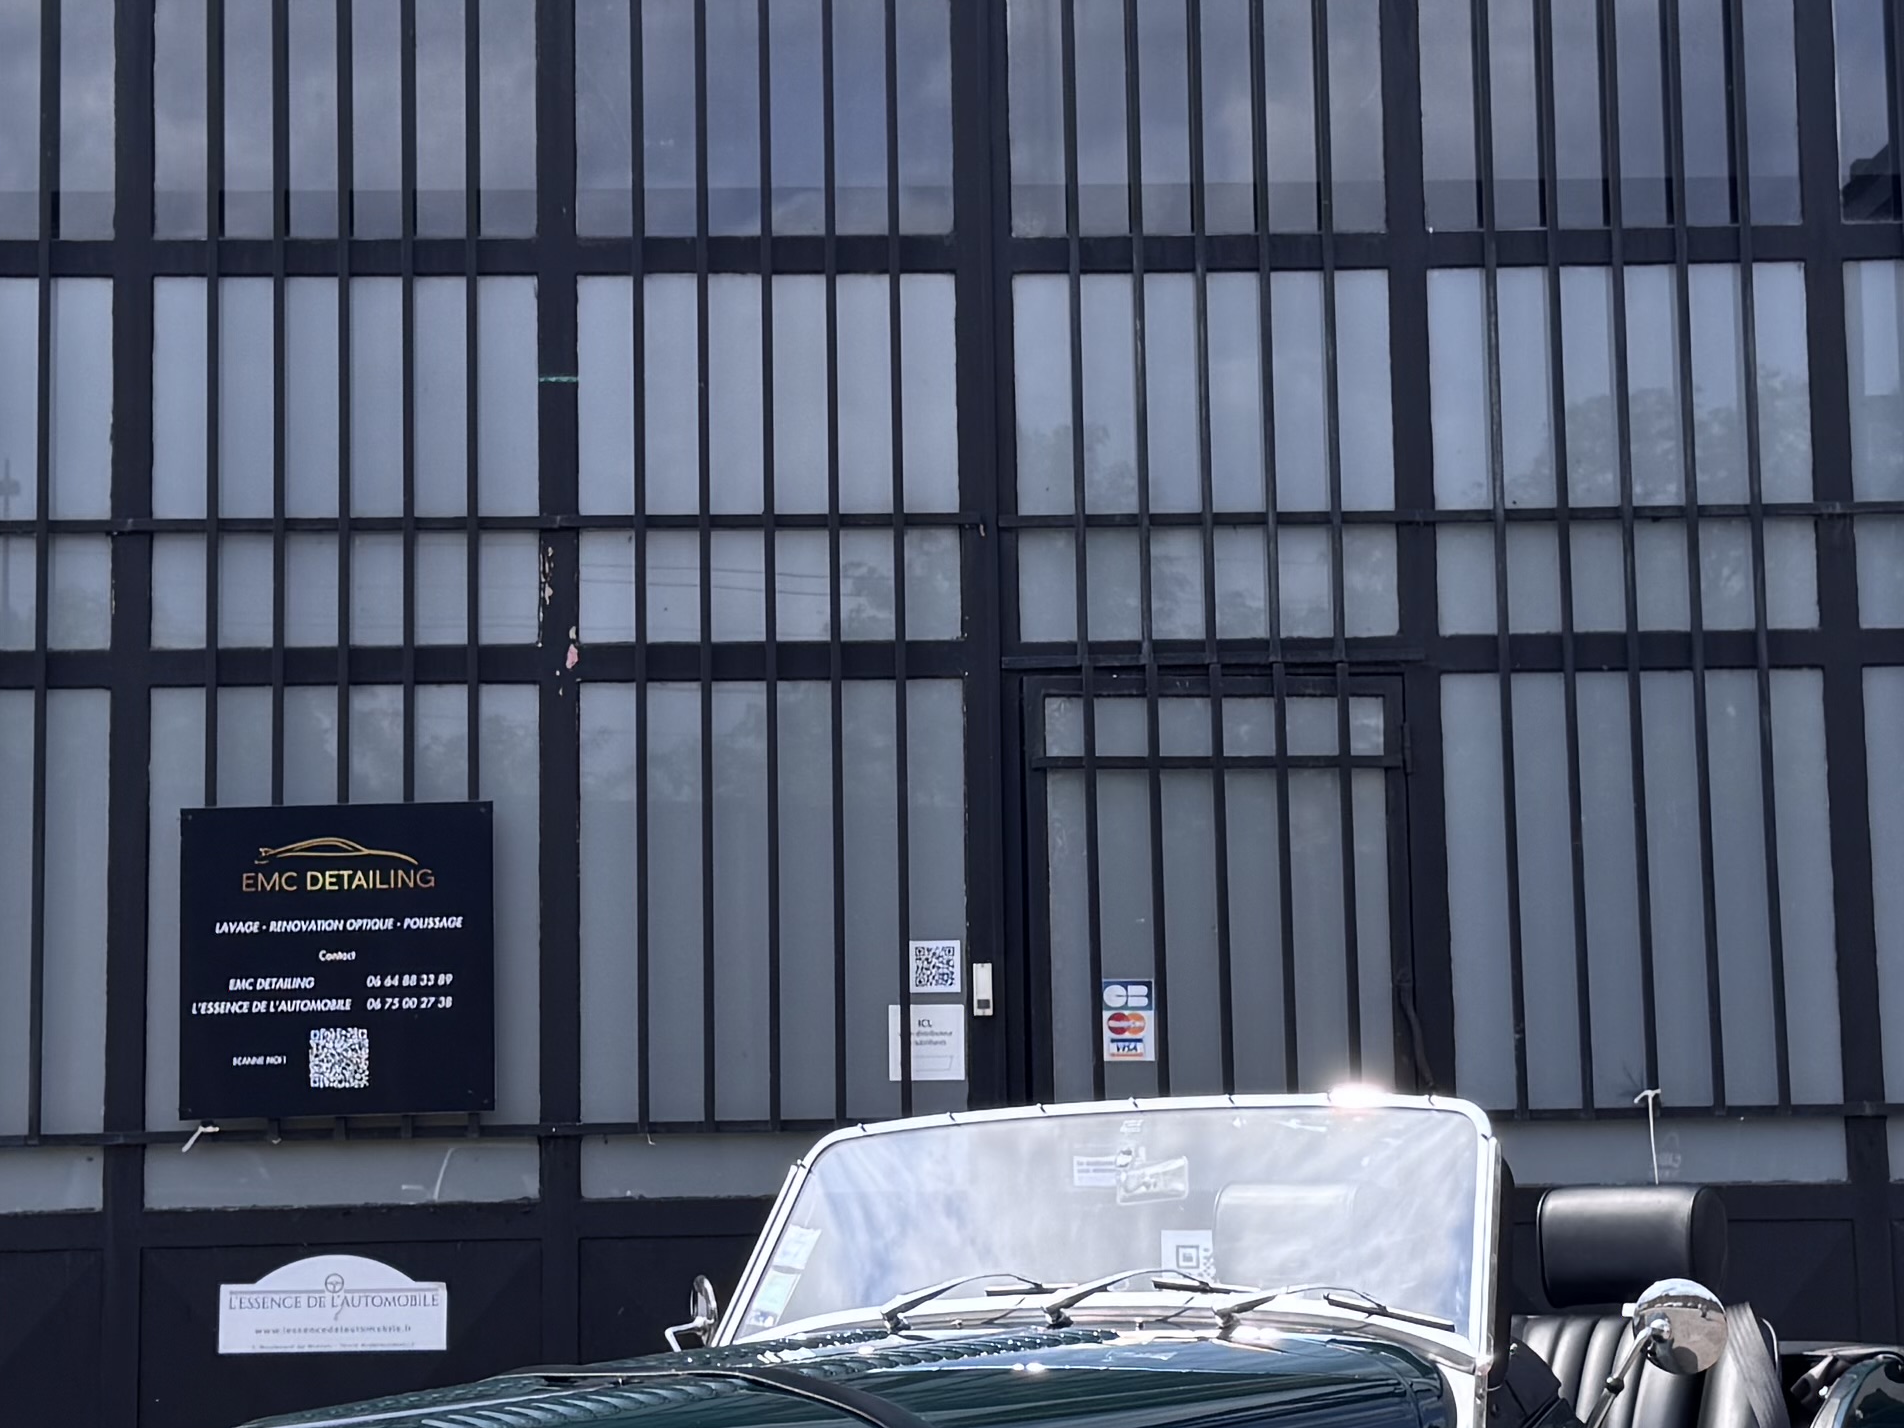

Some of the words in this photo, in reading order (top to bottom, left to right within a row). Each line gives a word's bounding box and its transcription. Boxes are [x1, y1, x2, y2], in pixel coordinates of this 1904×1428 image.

[242, 872, 298, 892] EMC
[306, 869, 435, 891] DETAILING
[215, 921, 260, 934] LAVAGE
[346, 917, 394, 931] OPTIQUE
[318, 949, 356, 961] Contact
[229, 978, 254, 991] EMC
[256, 976, 315, 990] DETAILING
[366, 975, 381, 987] 06
[420, 974, 435, 986] 33
[366, 998, 381, 1010] 06
[384, 998, 399, 1010] 75
[402, 997, 417, 1009] 00
[420, 997, 435, 1008] 27
[1103, 984, 1149, 1008] CB
[192, 1001, 250, 1015] L'ESSENCE
[252, 1000, 268, 1013] DE
[269, 998, 352, 1013] L'AUTOMOBILE
[1116, 1043, 1138, 1052] VISA
[228, 1295, 301, 1310] L'ESSENCE
[307, 1295, 326, 1309] DE
[331, 1293, 439, 1309] L'AUTOMOBILE
